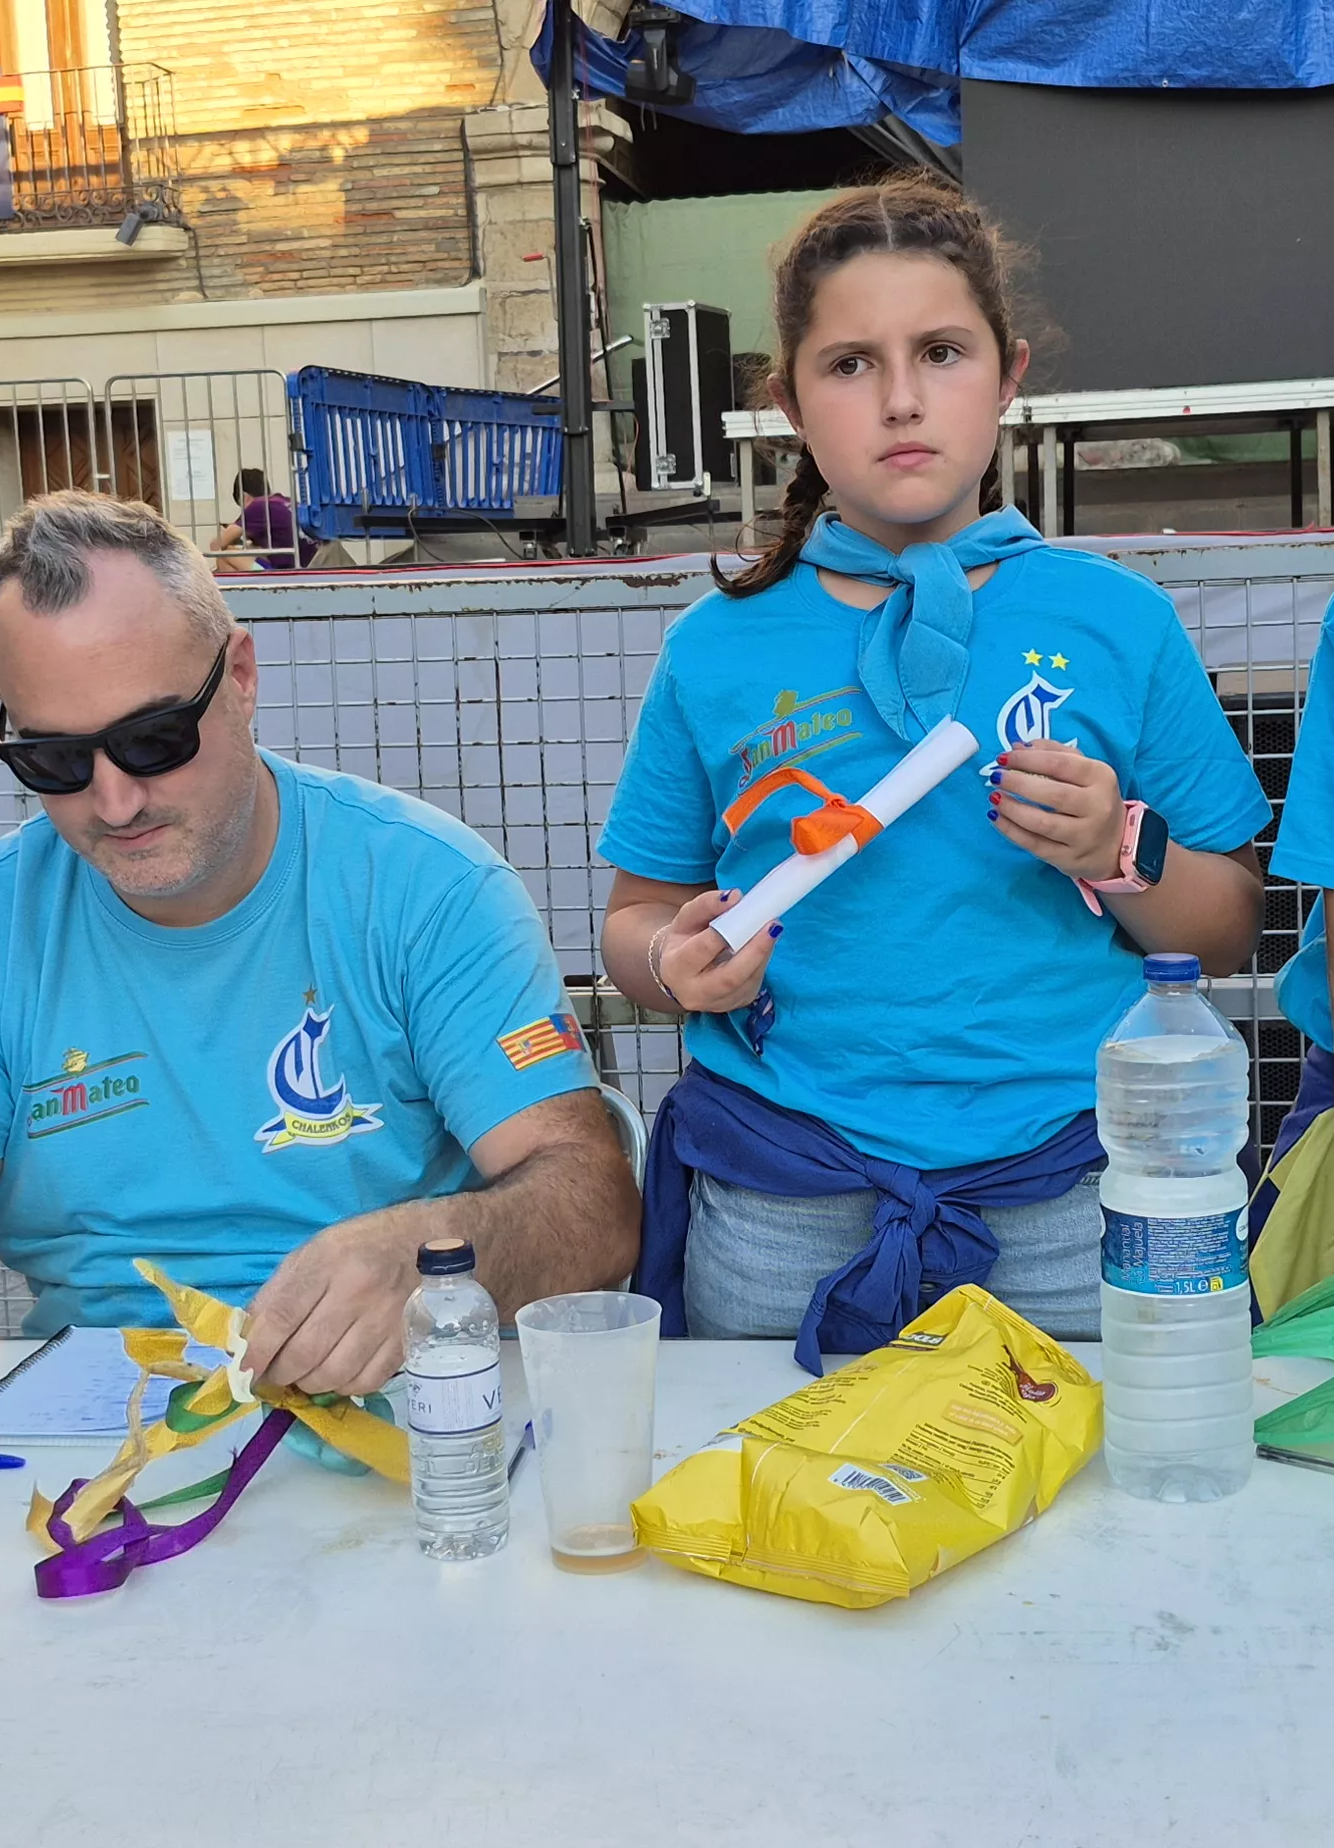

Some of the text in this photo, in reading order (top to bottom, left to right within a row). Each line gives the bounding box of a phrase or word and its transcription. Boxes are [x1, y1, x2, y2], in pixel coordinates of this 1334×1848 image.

[27, 1075, 140, 1127] an Mateo
[1120, 1223, 1132, 1281] Manantial
[1131, 1221, 1147, 1267] Majuela
[1176, 1281, 1196, 1294] 1,5L
[408, 1398, 432, 1414] ERI
